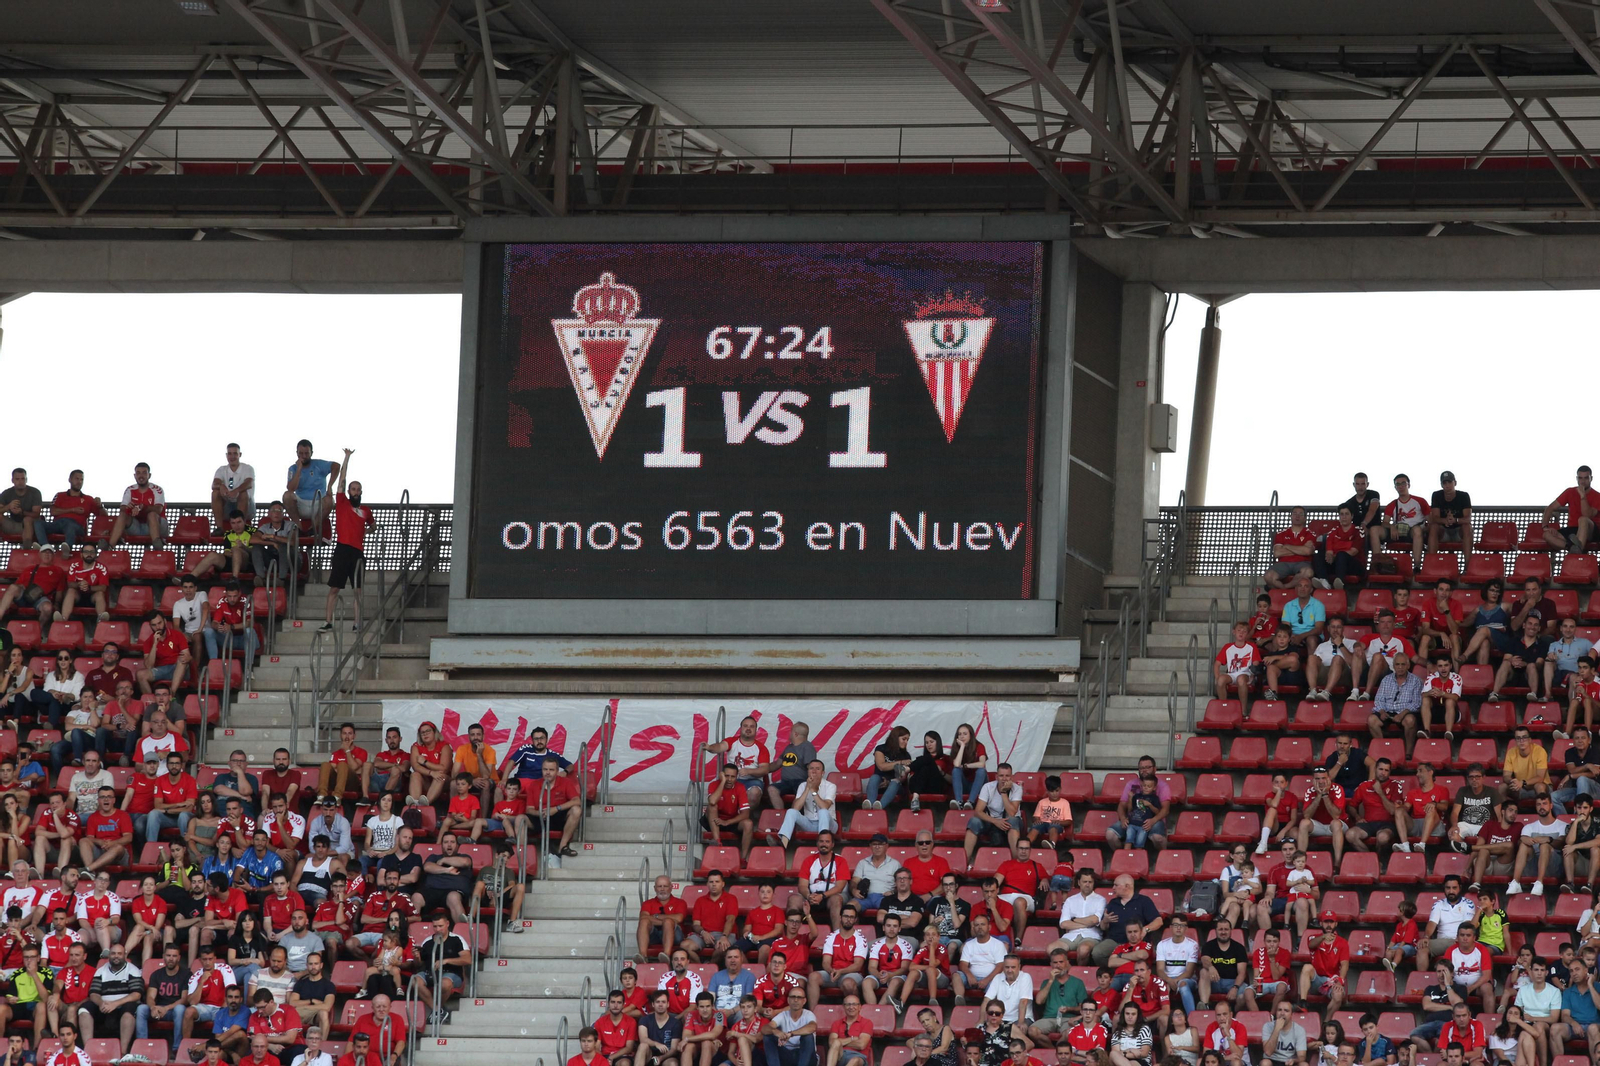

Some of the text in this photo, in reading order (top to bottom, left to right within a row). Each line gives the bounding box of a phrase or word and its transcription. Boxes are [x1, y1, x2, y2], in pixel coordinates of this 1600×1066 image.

[705, 326, 835, 361] 67:24
[643, 386, 887, 469] 1 VS 1
[502, 510, 1023, 551] omos 6563 en Nuev
[1463, 797, 1491, 807] RAMONES
[159, 982, 180, 996] 501
[1276, 1041, 1295, 1051] ILA
